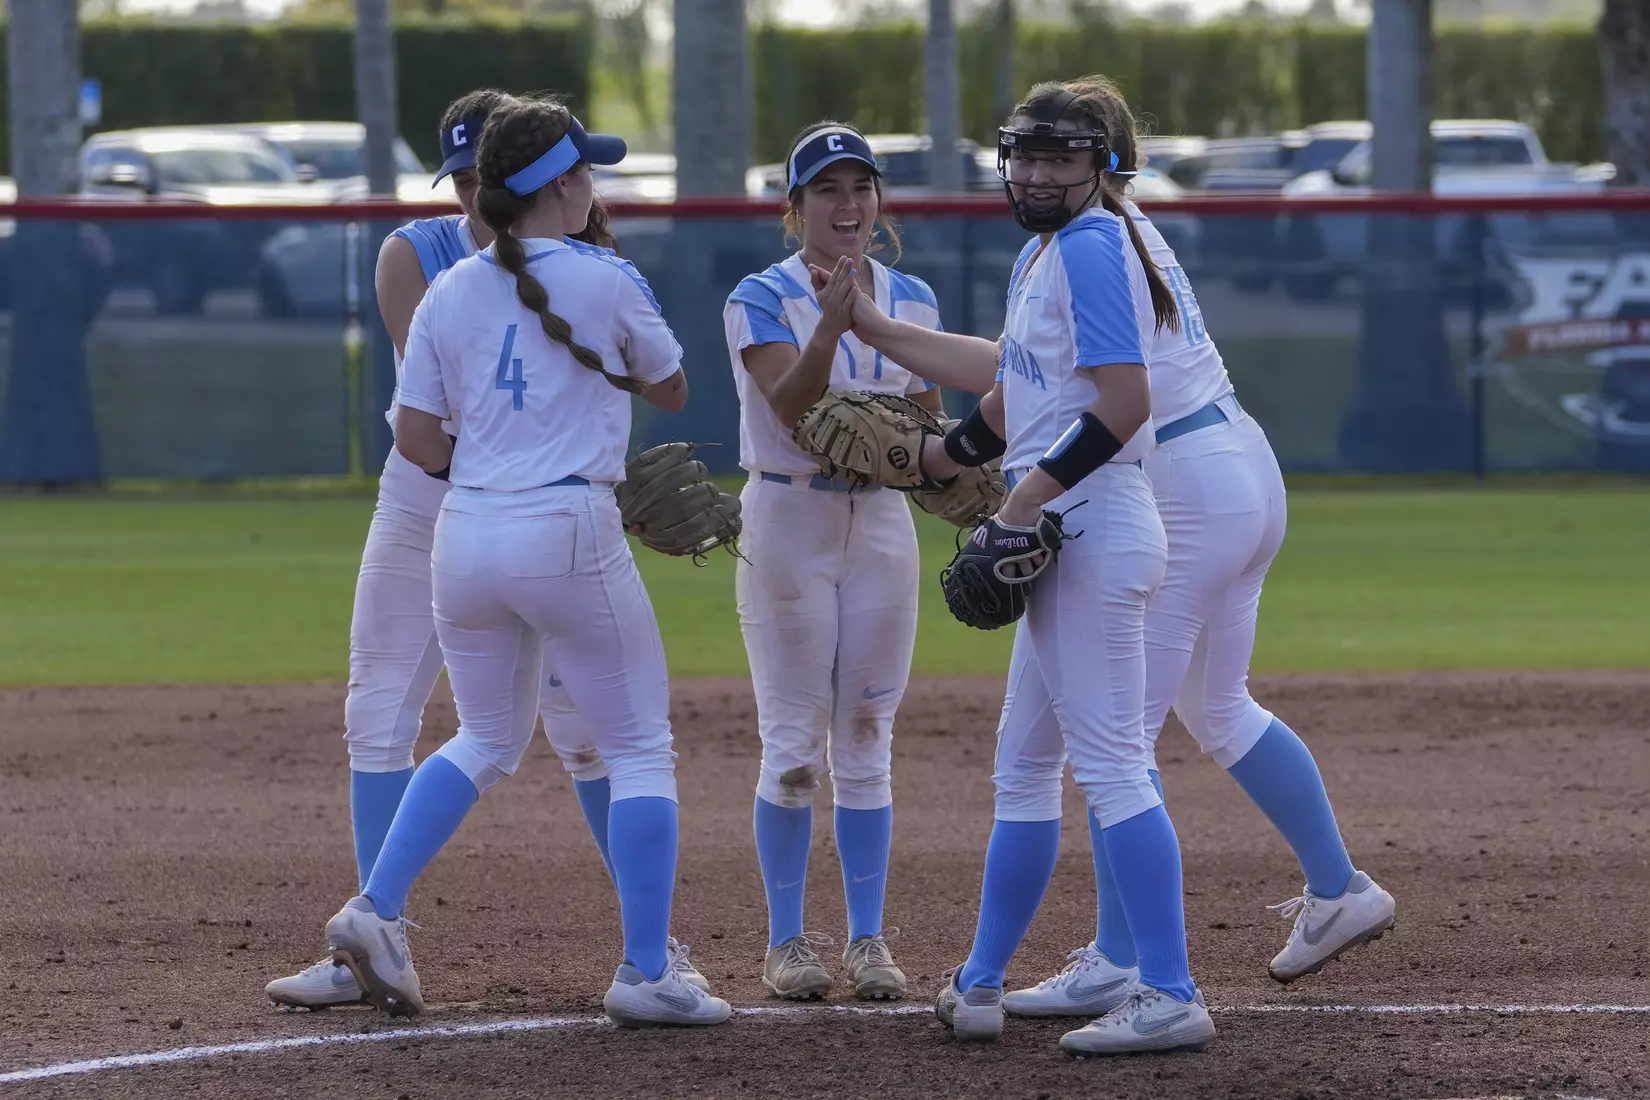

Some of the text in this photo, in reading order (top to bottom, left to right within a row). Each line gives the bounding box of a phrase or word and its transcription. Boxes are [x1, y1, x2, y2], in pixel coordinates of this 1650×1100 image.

[452, 124, 467, 146] C
[827, 135, 844, 152] C
[496, 324, 527, 411] 4
[994, 536, 1029, 549] Wilson
